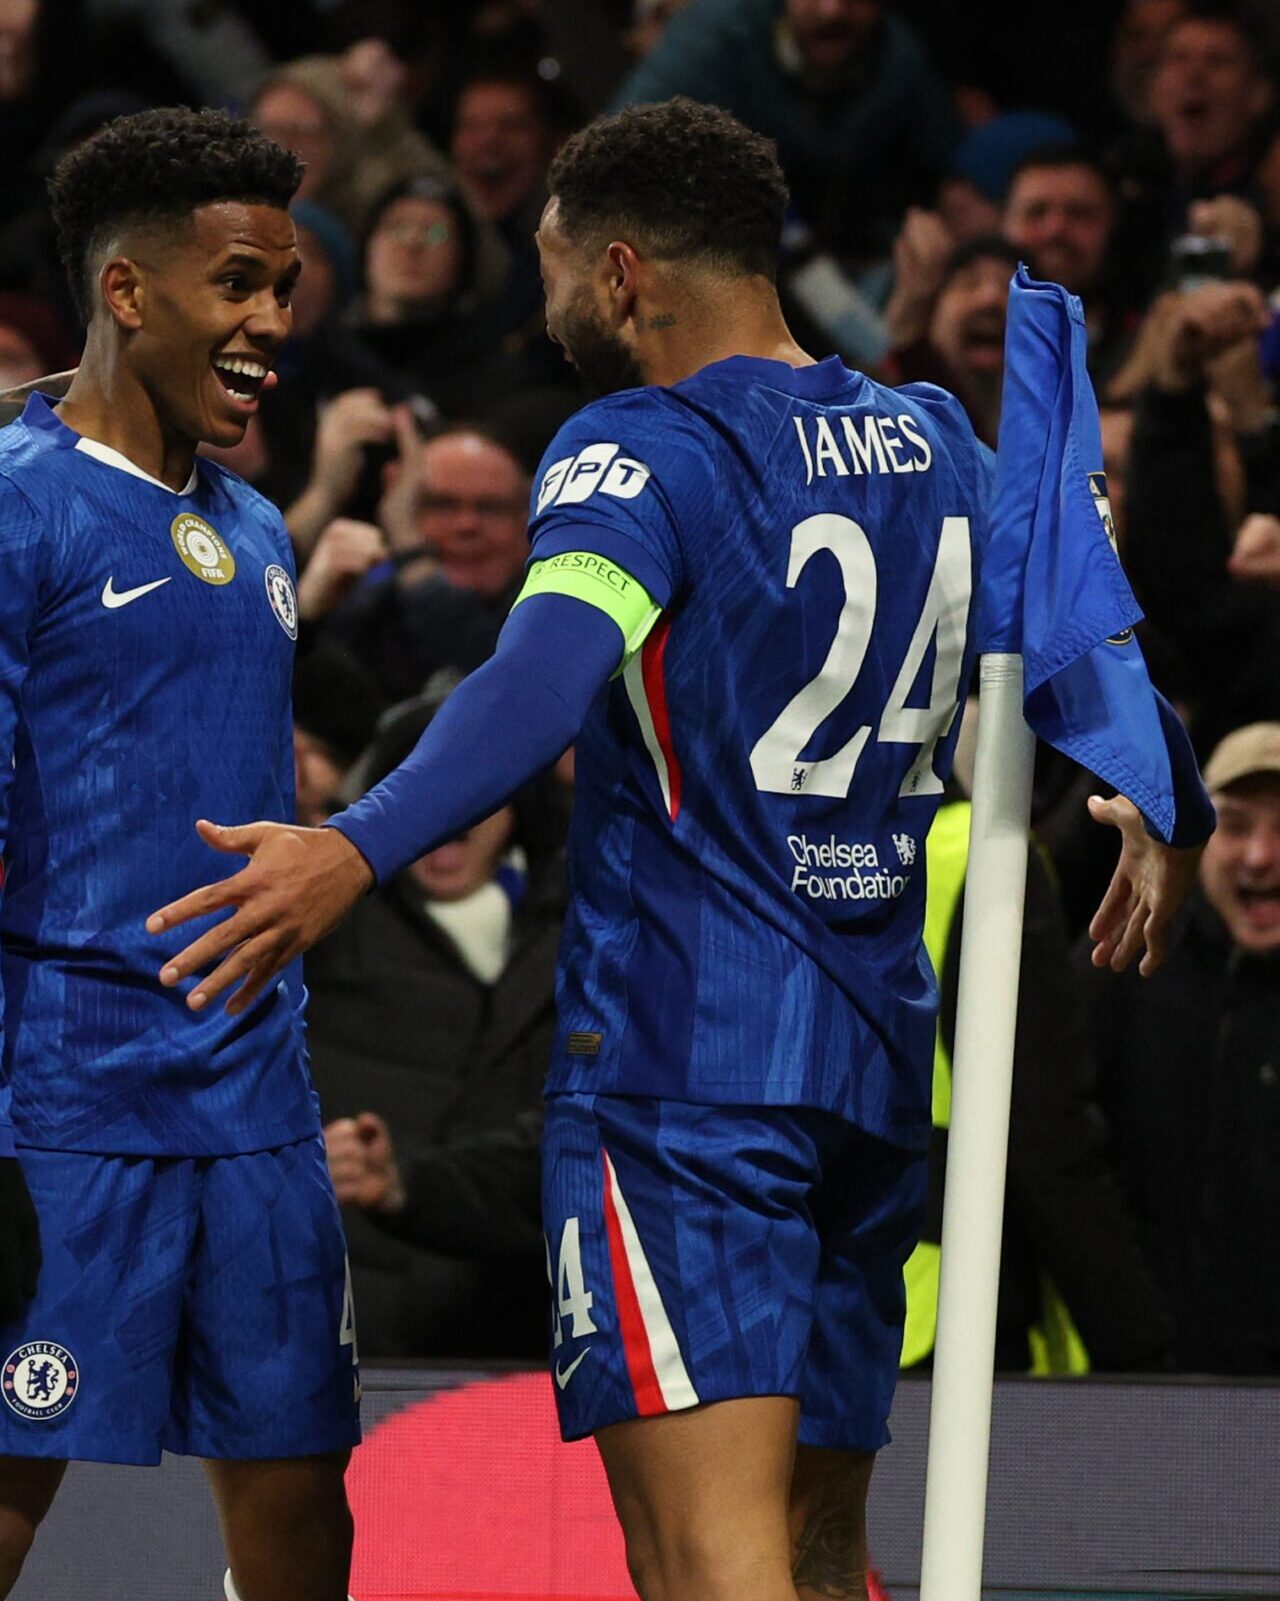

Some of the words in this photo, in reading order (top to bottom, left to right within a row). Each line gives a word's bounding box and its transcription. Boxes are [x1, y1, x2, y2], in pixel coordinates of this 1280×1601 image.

[793, 415, 933, 486] JAMES
[537, 450, 647, 508] FPT
[176, 523, 190, 556] WORLD
[184, 518, 228, 560] CHAMPIONS
[200, 567, 226, 579] FIFA
[549, 554, 631, 592] RESPECT
[748, 512, 973, 799] 24
[787, 834, 879, 868] Chelsea
[18, 1344, 68, 1363] CHELSEA
